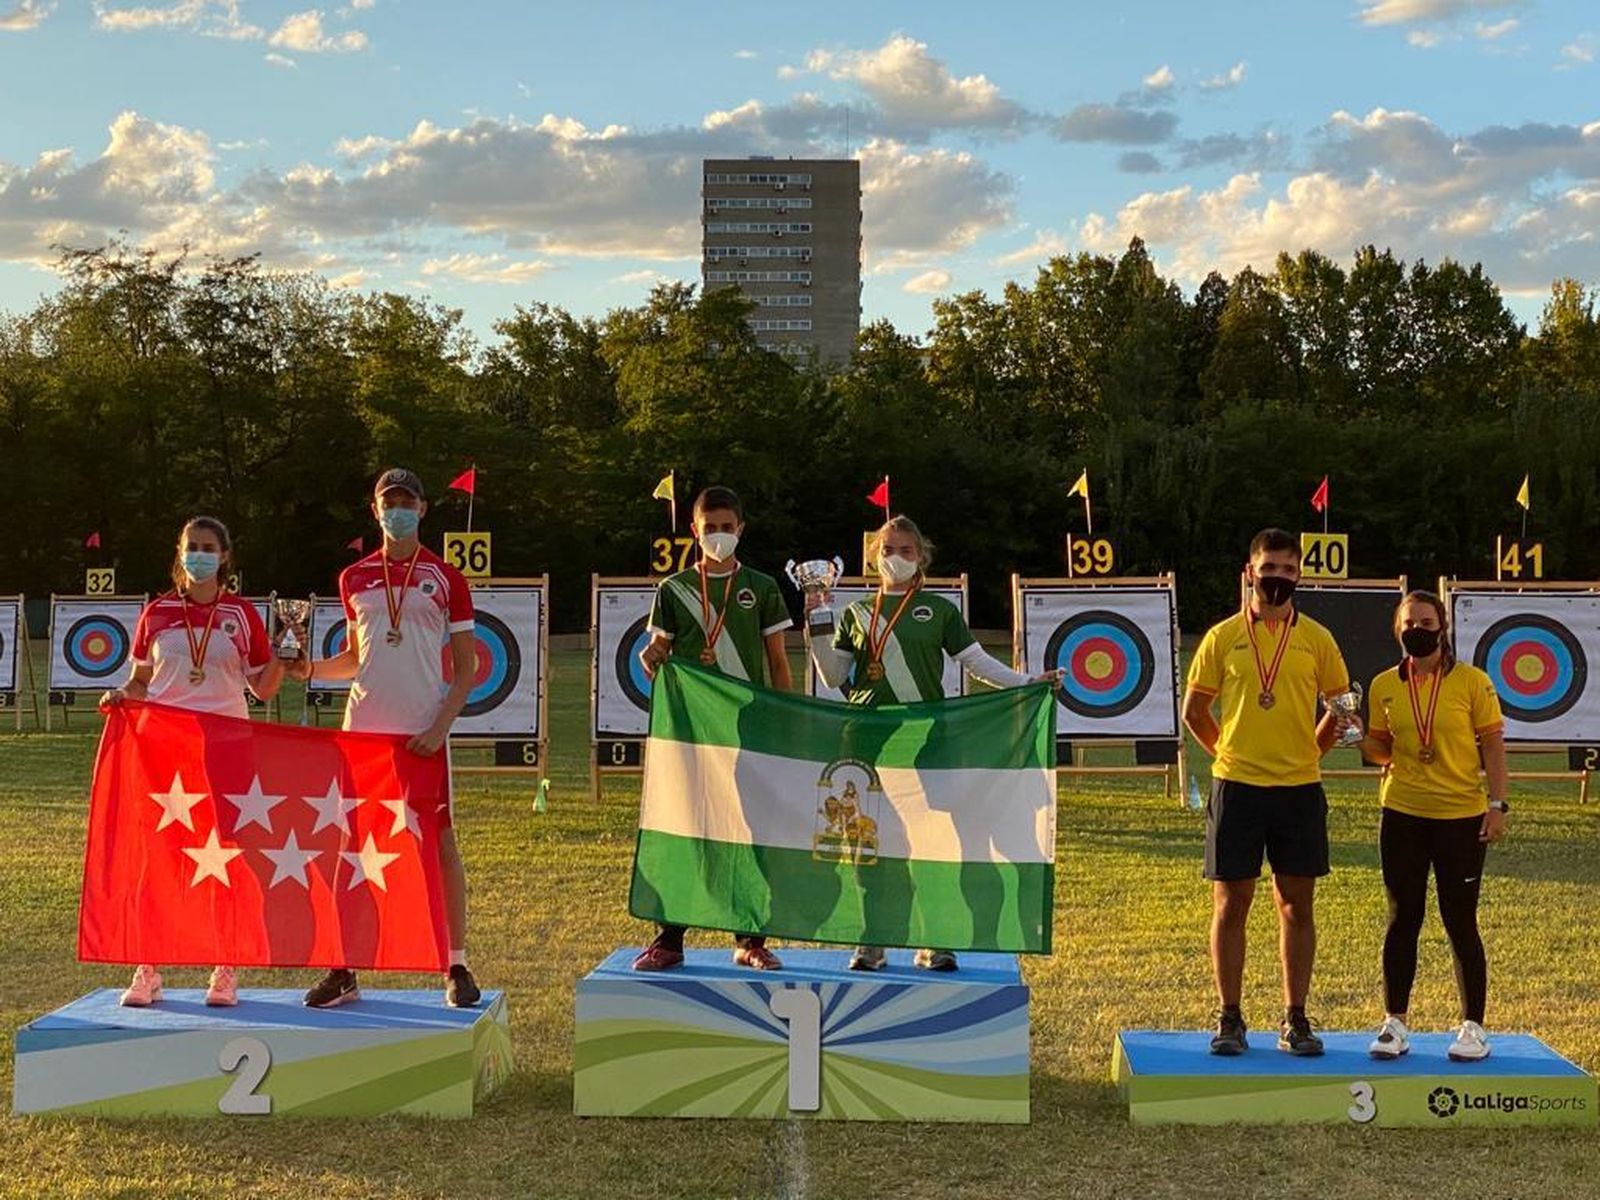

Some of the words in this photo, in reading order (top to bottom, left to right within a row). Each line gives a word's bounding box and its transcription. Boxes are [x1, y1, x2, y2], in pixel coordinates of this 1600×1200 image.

[448, 539, 488, 573] 36
[653, 537, 694, 573] 37
[1072, 539, 1114, 574] 39
[1303, 540, 1345, 575] 40
[1502, 543, 1543, 578] 41
[88, 573, 113, 593] 32
[523, 743, 536, 764] 6
[1584, 748, 1598, 770] 2
[770, 989, 821, 1112] 1
[218, 1038, 272, 1115] 2
[1348, 1081, 1377, 1124] 3
